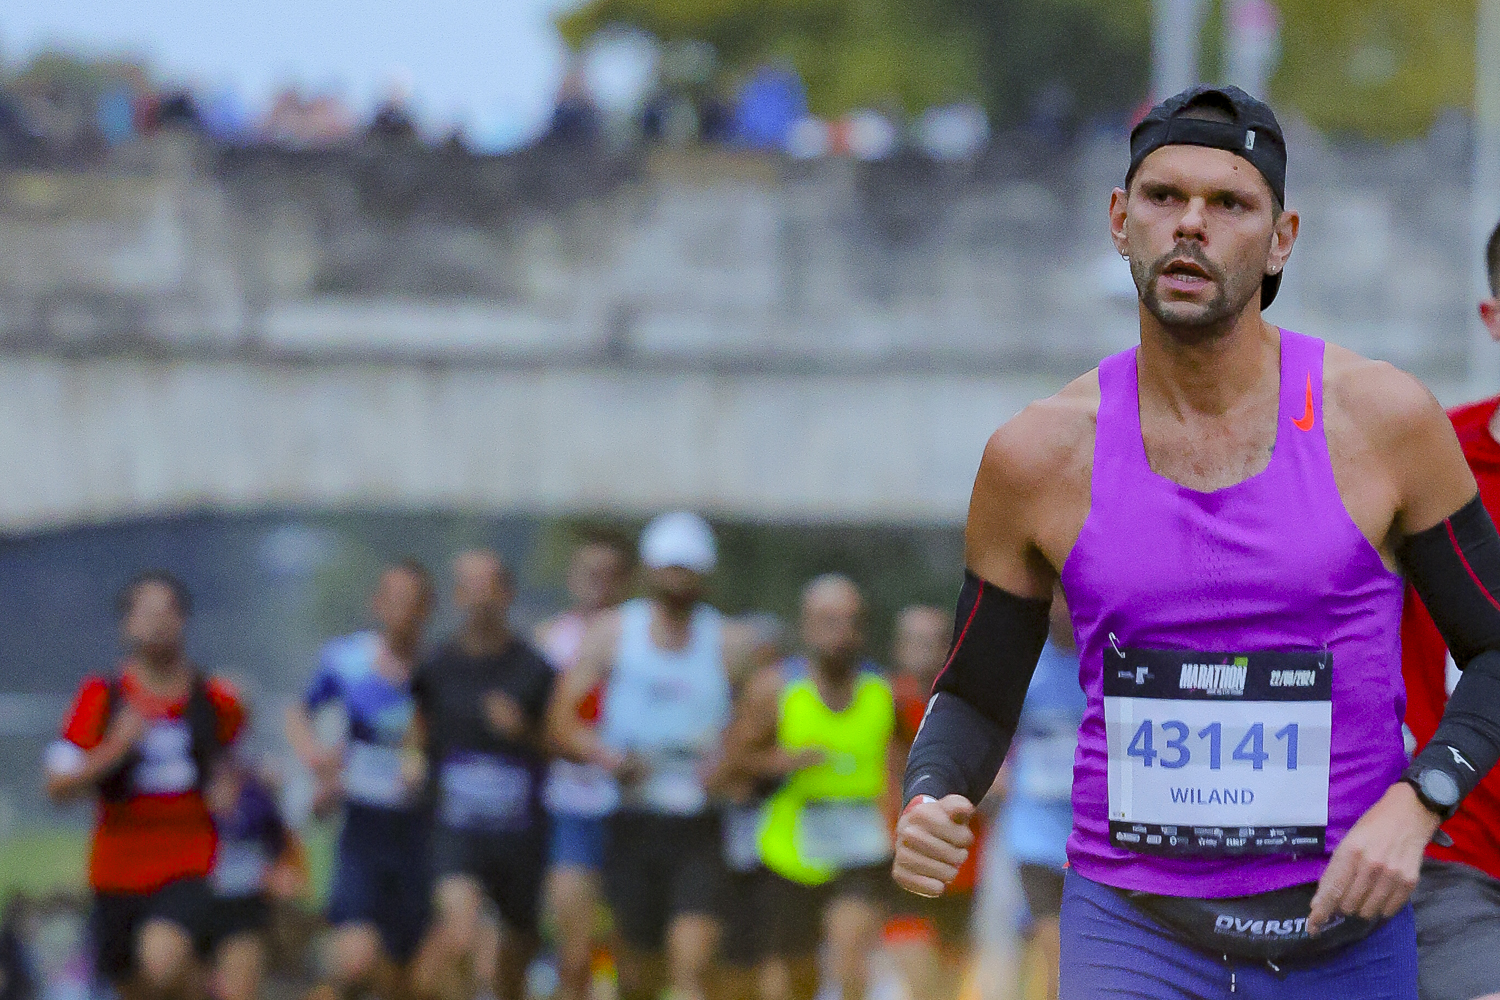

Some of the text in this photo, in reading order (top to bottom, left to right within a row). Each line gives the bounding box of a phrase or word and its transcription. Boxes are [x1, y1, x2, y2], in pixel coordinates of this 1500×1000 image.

[1126, 719, 1299, 770] 43141
[1170, 786, 1255, 806] WILAND
[1214, 914, 1309, 936] OVERST
